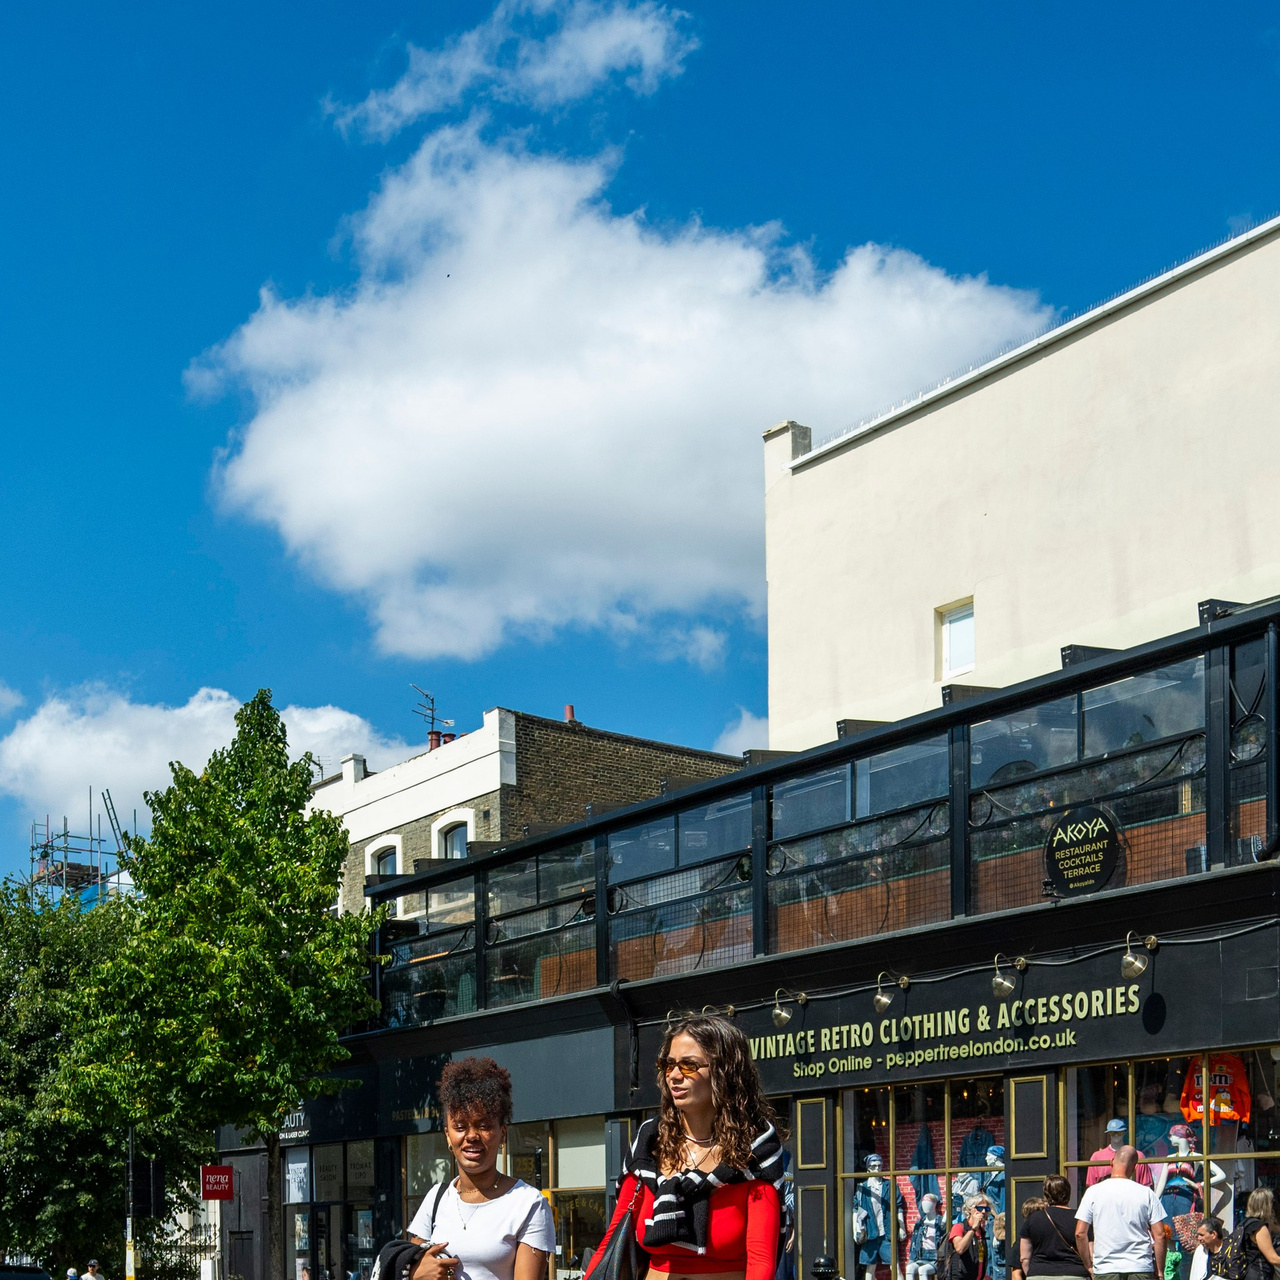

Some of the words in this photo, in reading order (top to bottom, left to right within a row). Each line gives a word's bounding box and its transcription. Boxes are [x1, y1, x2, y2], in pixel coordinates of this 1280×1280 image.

[1053, 817, 1109, 847] AKOYA
[1055, 840, 1109, 860] RESTAURANT
[1058, 852, 1104, 870] COCKTAILS
[1063, 863, 1101, 879] TERRACE
[749, 1029, 816, 1060] VINTAGE
[820, 1021, 874, 1052] RETRO
[880, 1007, 970, 1044] CLOTHING
[977, 1004, 991, 1032] &
[996, 984, 1140, 1029] ACCESSORIES
[793, 1061, 825, 1078] Shop
[828, 1055, 873, 1073] Online
[886, 1028, 1077, 1069] peppertreelondon.co.uk
[281, 1112, 306, 1129] AUTY
[206, 1174, 229, 1183] nena
